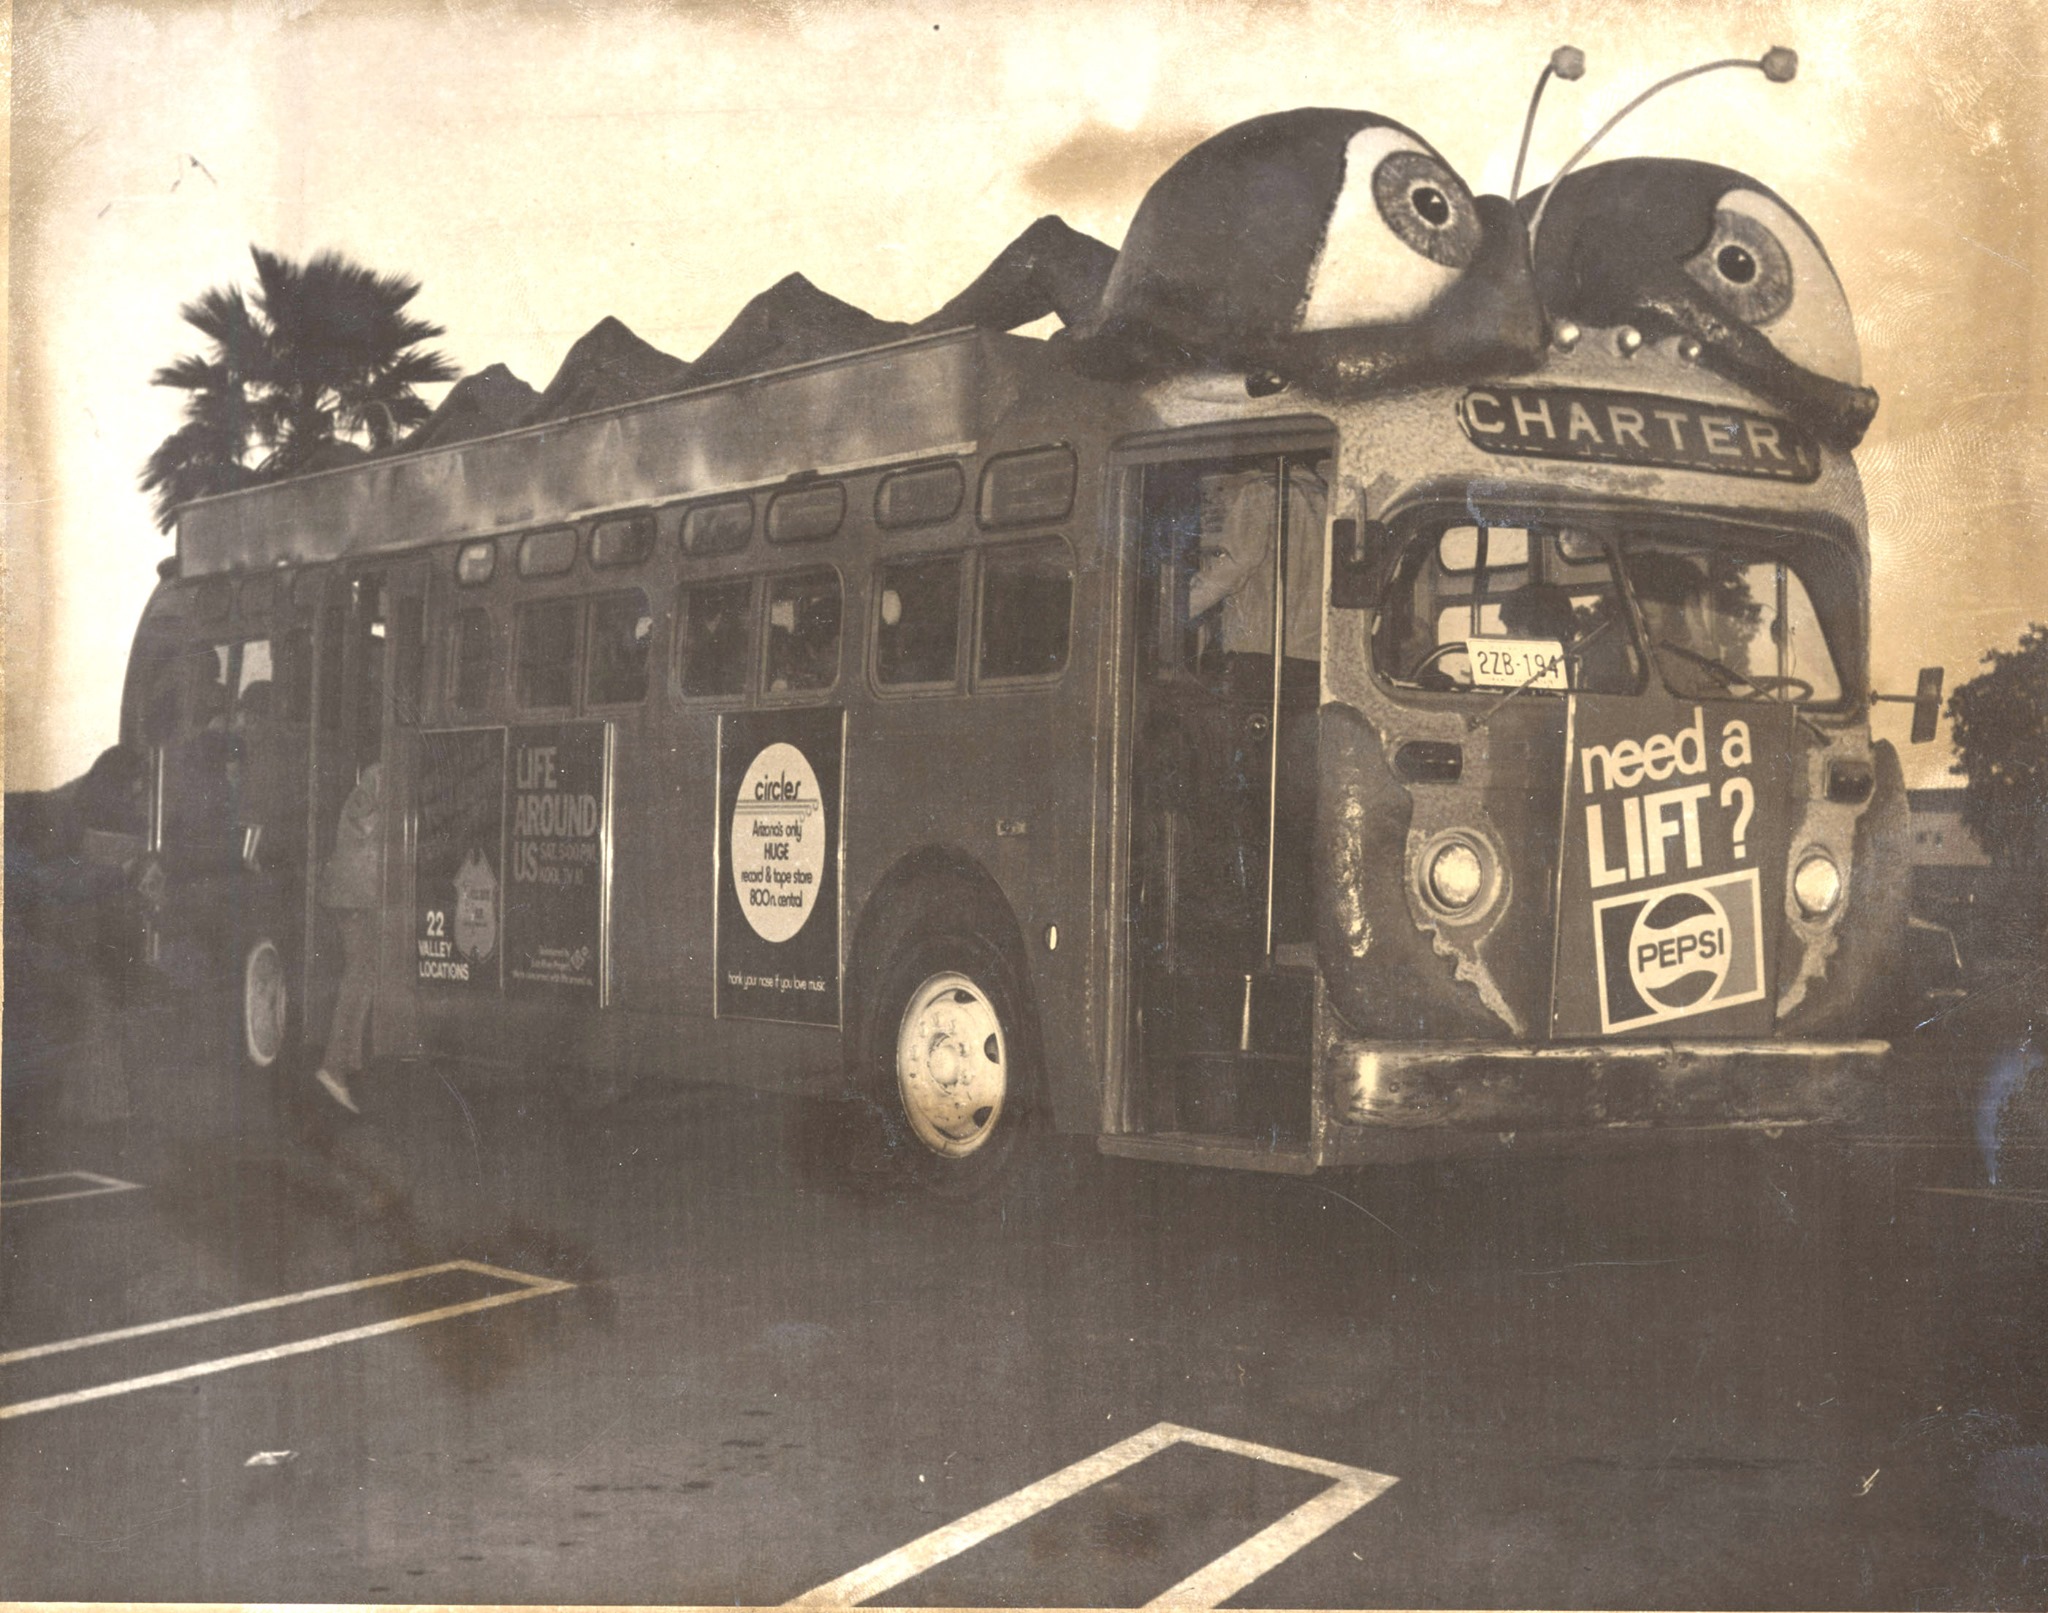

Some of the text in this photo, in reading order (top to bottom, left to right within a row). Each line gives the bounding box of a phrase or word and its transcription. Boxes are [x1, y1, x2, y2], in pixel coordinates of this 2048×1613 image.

[1464, 391, 1786, 462] CHARTER
[1580, 705, 1753, 795] need a
[516, 745, 558, 790] LIFE
[754, 769, 801, 801] circles
[513, 793, 598, 838] AROUND
[752, 820, 802, 842] Arizona's only
[512, 841, 538, 883] US
[763, 843, 790, 861] HUGE
[741, 866, 813, 888] record & tape store
[749, 889, 770, 907] 800
[778, 891, 803, 908] central
[425, 909, 445, 937] 22
[417, 939, 453, 958] VALLEY
[1636, 926, 1725, 974] PEPSI
[418, 960, 470, 982] LOCATIONS
